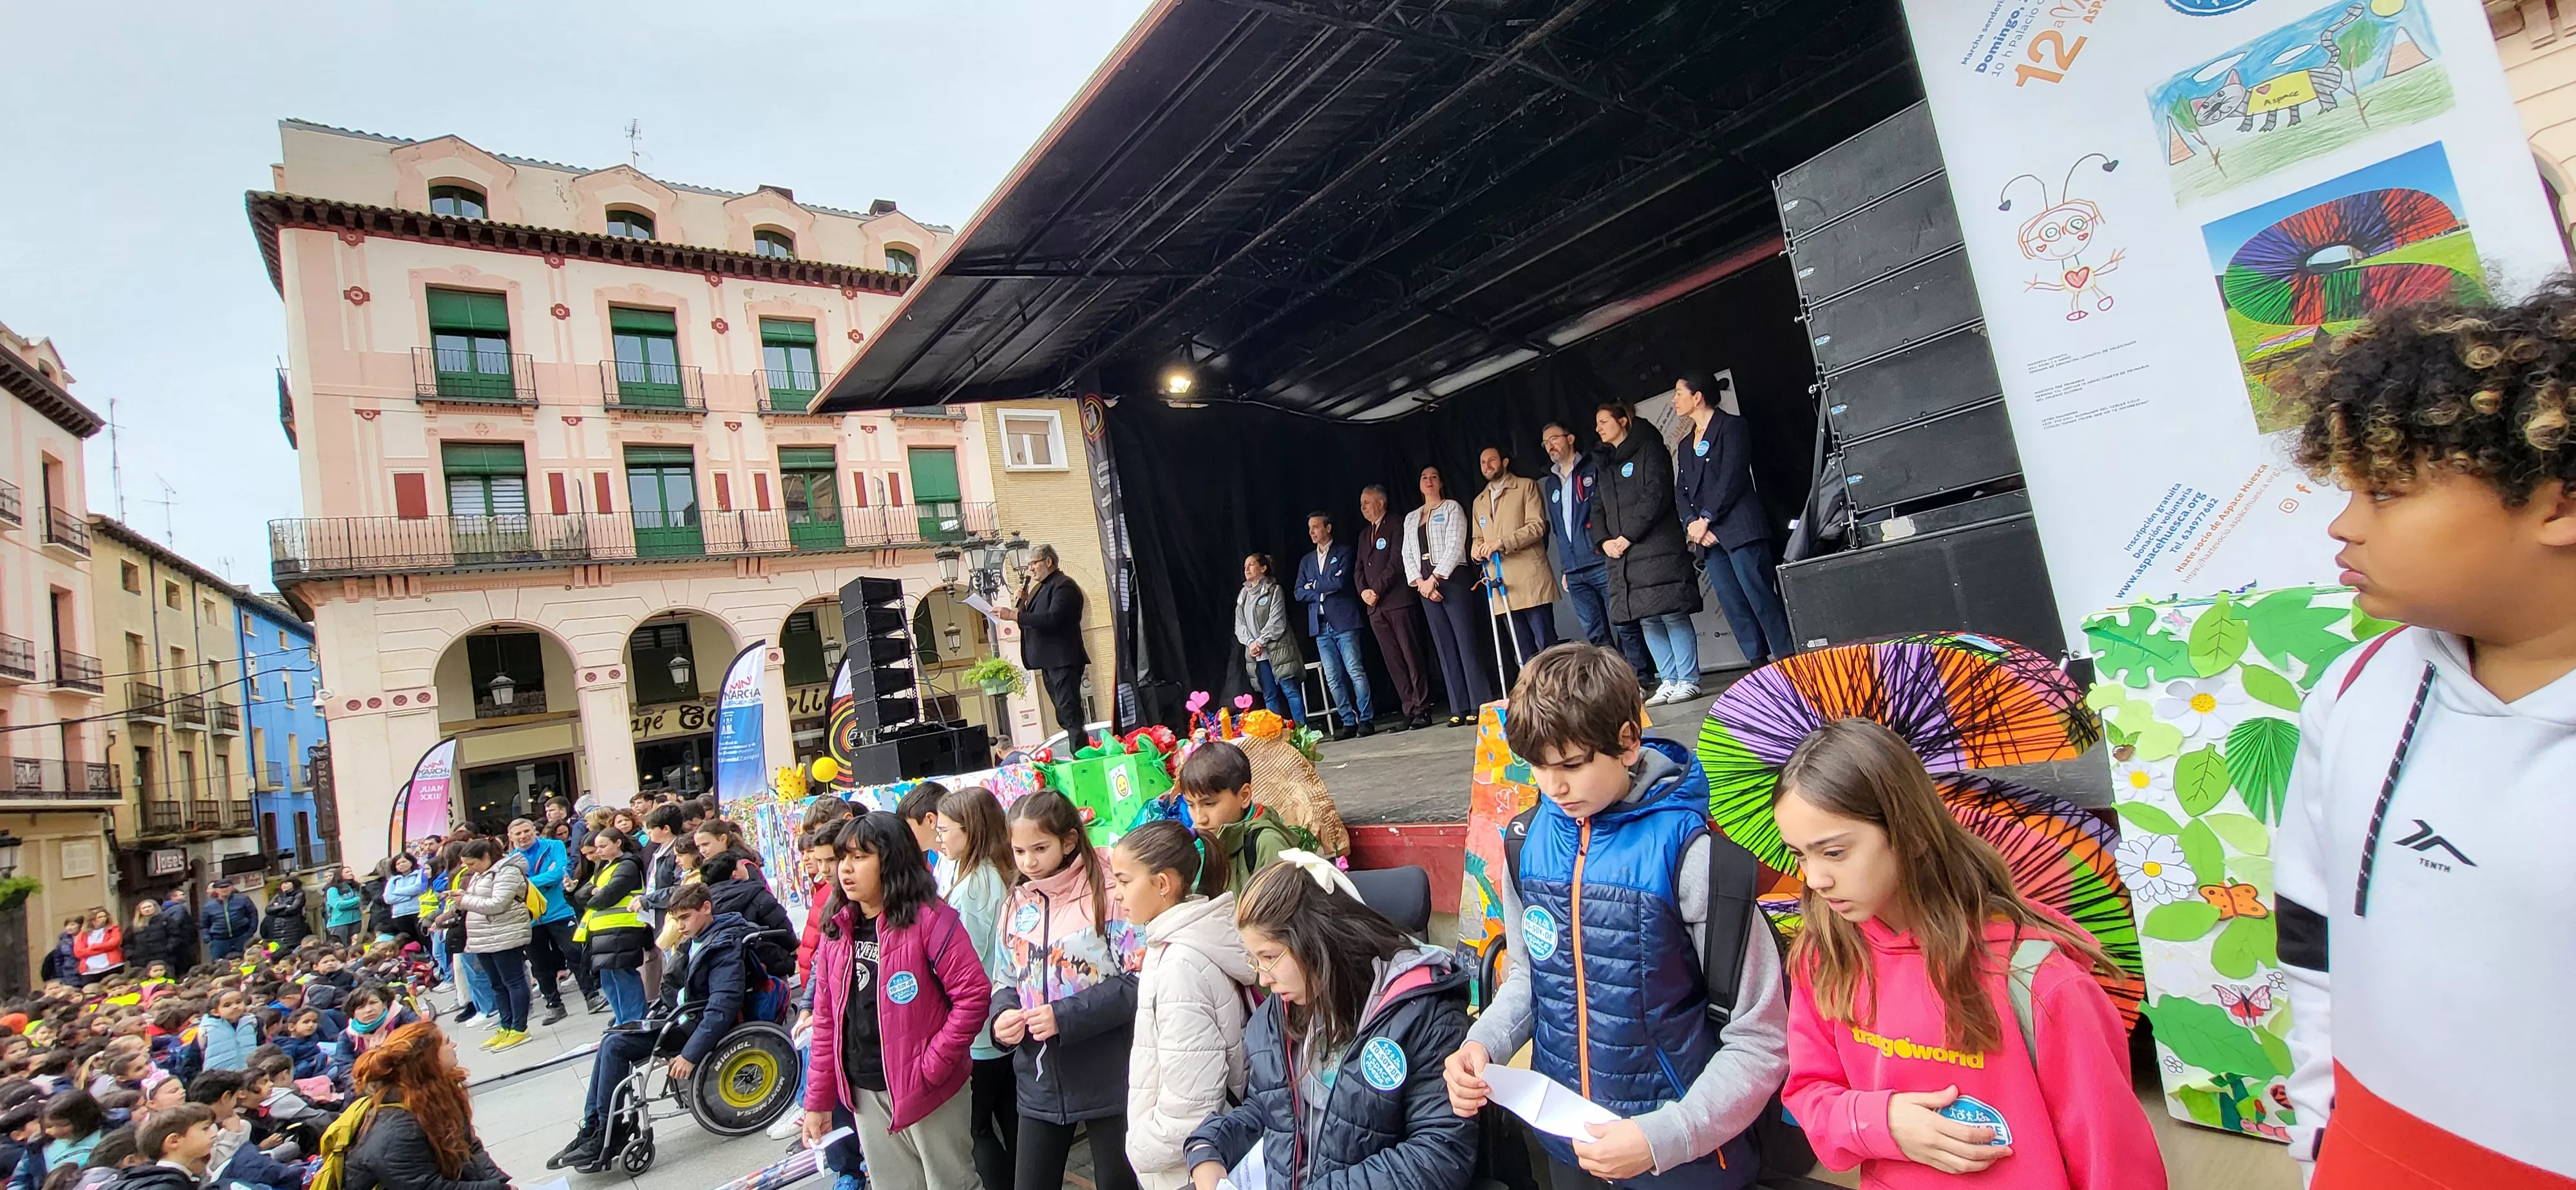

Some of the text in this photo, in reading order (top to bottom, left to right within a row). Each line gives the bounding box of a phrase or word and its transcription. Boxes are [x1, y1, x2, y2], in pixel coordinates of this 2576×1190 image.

[1961, 0, 2005, 65] Marcha senderi
[1975, 6, 2025, 73] Domingo,
[1991, 62, 2005, 77] 10
[2002, 50, 2013, 58] h
[2009, 8, 2039, 48] Palacio
[2014, 30, 2088, 87] 12
[2116, 491, 2207, 598] www.aspacehuesca.org
[2123, 483, 2182, 551] Inscripción gratuita
[2132, 487, 2193, 559] Donación voluntaria
[2169, 498, 2219, 553] Tel. 634977682
[2175, 463, 2268, 572] Hazte socio de Aspace Huesca
[630, 709, 667, 738] afé
[419, 785, 444, 793] JUAN
[2419, 858, 2450, 873] TENTH
[714, 1041, 752, 1072] MIGUEL
[737, 1076, 785, 1117] MONTMESA
